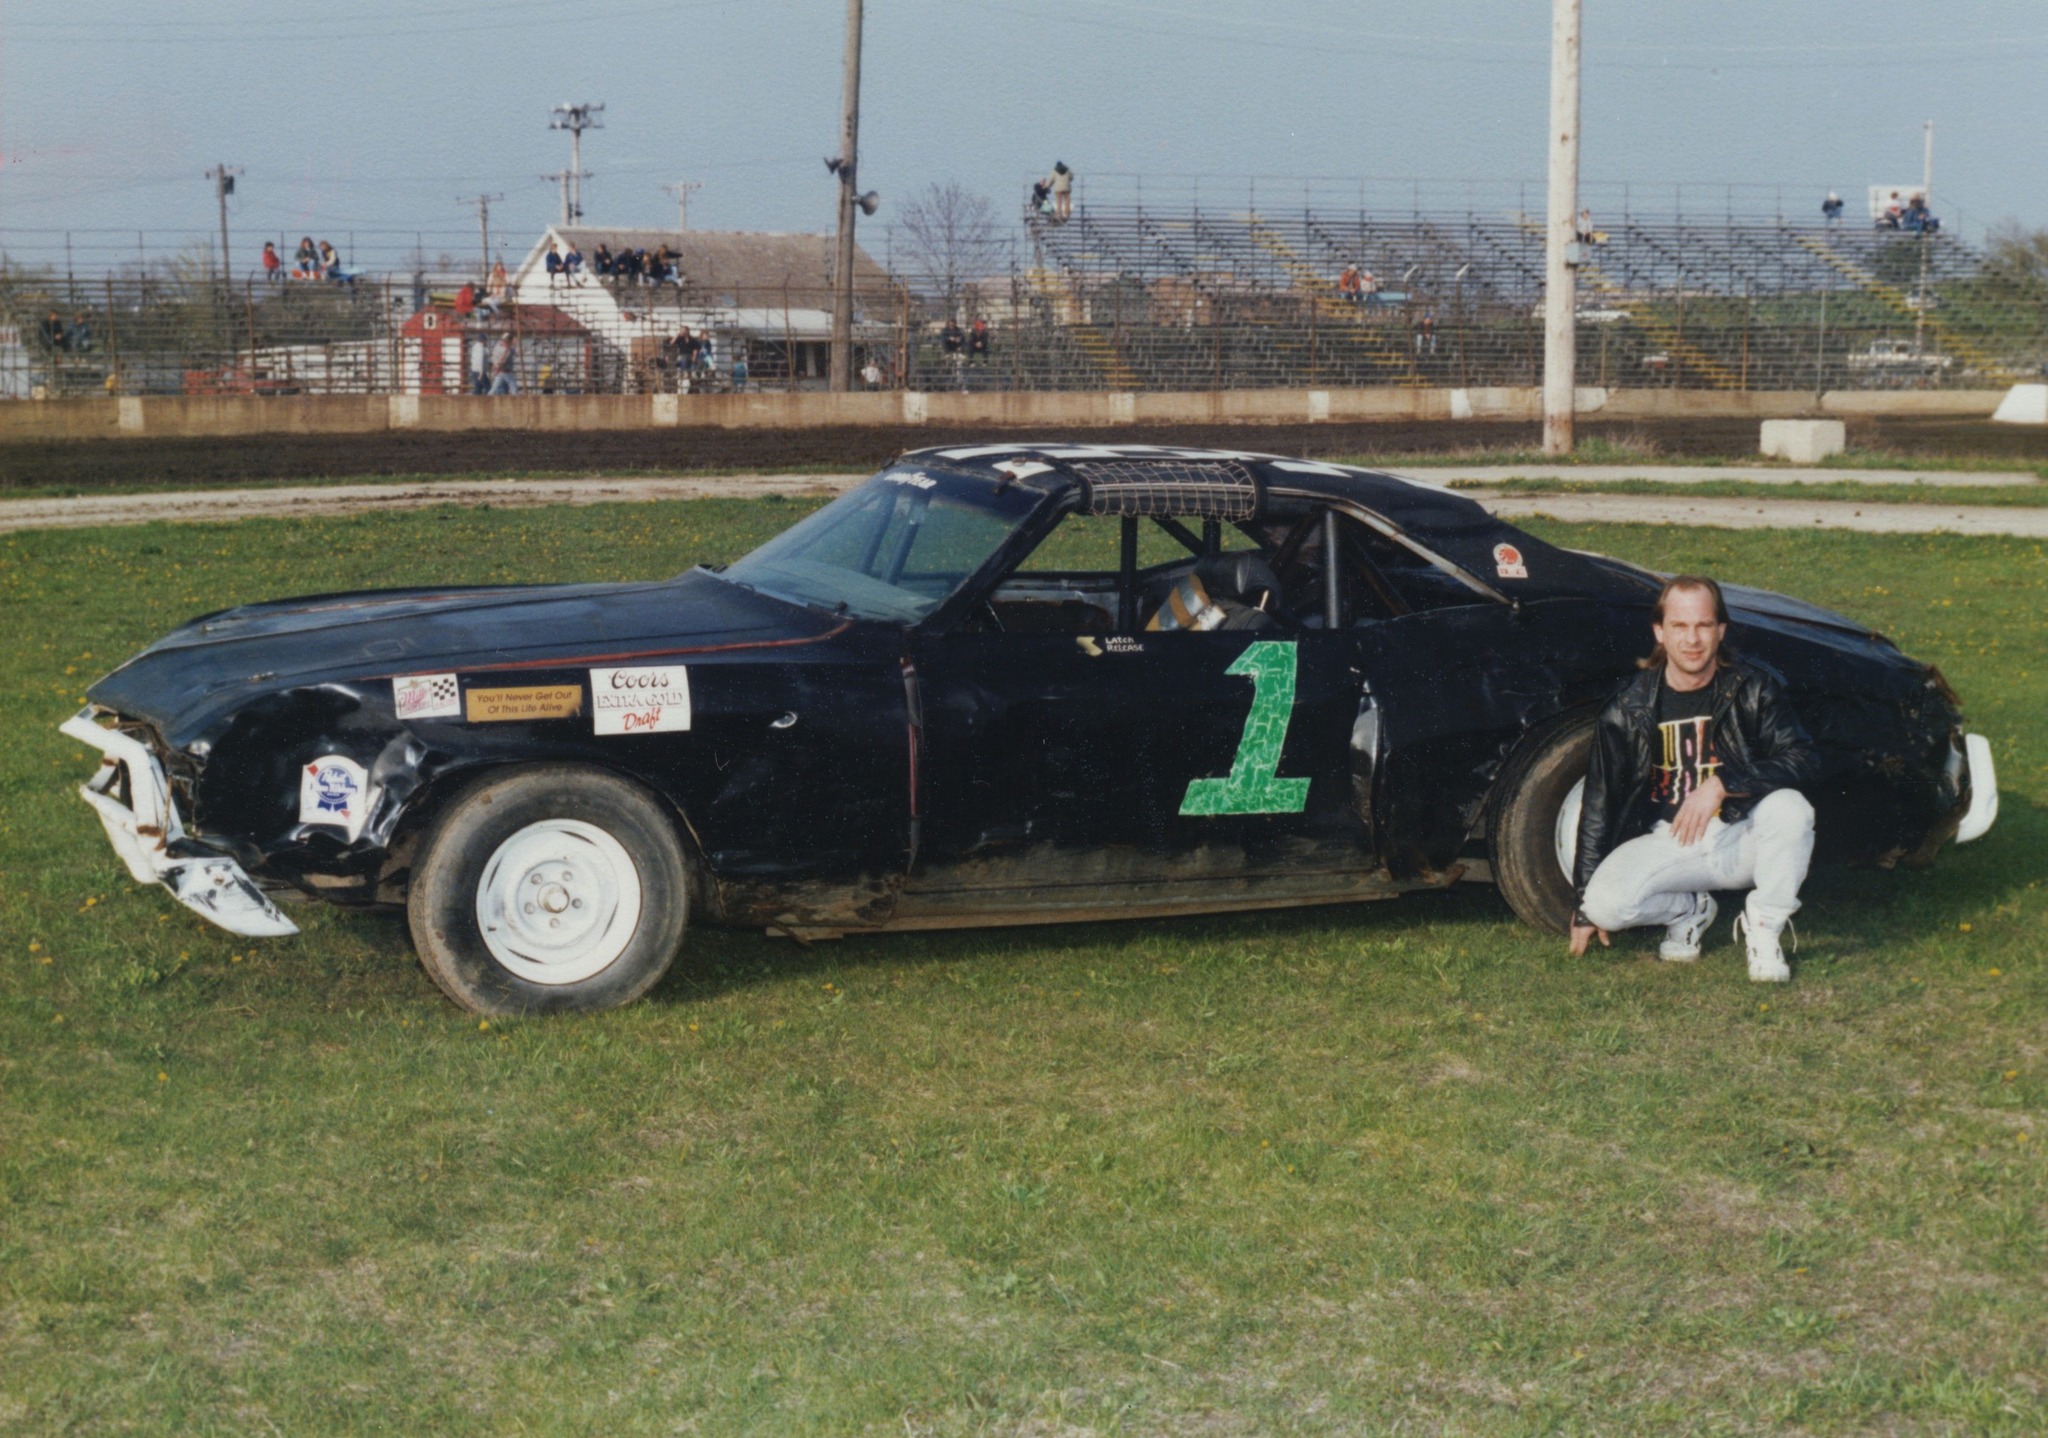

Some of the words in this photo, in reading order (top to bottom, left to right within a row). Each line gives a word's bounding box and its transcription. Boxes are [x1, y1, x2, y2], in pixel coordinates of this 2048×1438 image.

[609, 670, 669, 690] Coors
[477, 694, 503, 703] You'll
[506, 693, 533, 701] Never
[535, 691, 553, 701] Get
[555, 690, 573, 700] Out
[487, 705, 499, 714] Of
[502, 704, 519, 713] This
[521, 703, 537, 713] Life
[540, 703, 563, 712] Alive
[622, 707, 662, 730] Draft
[1178, 641, 1312, 816] 1
